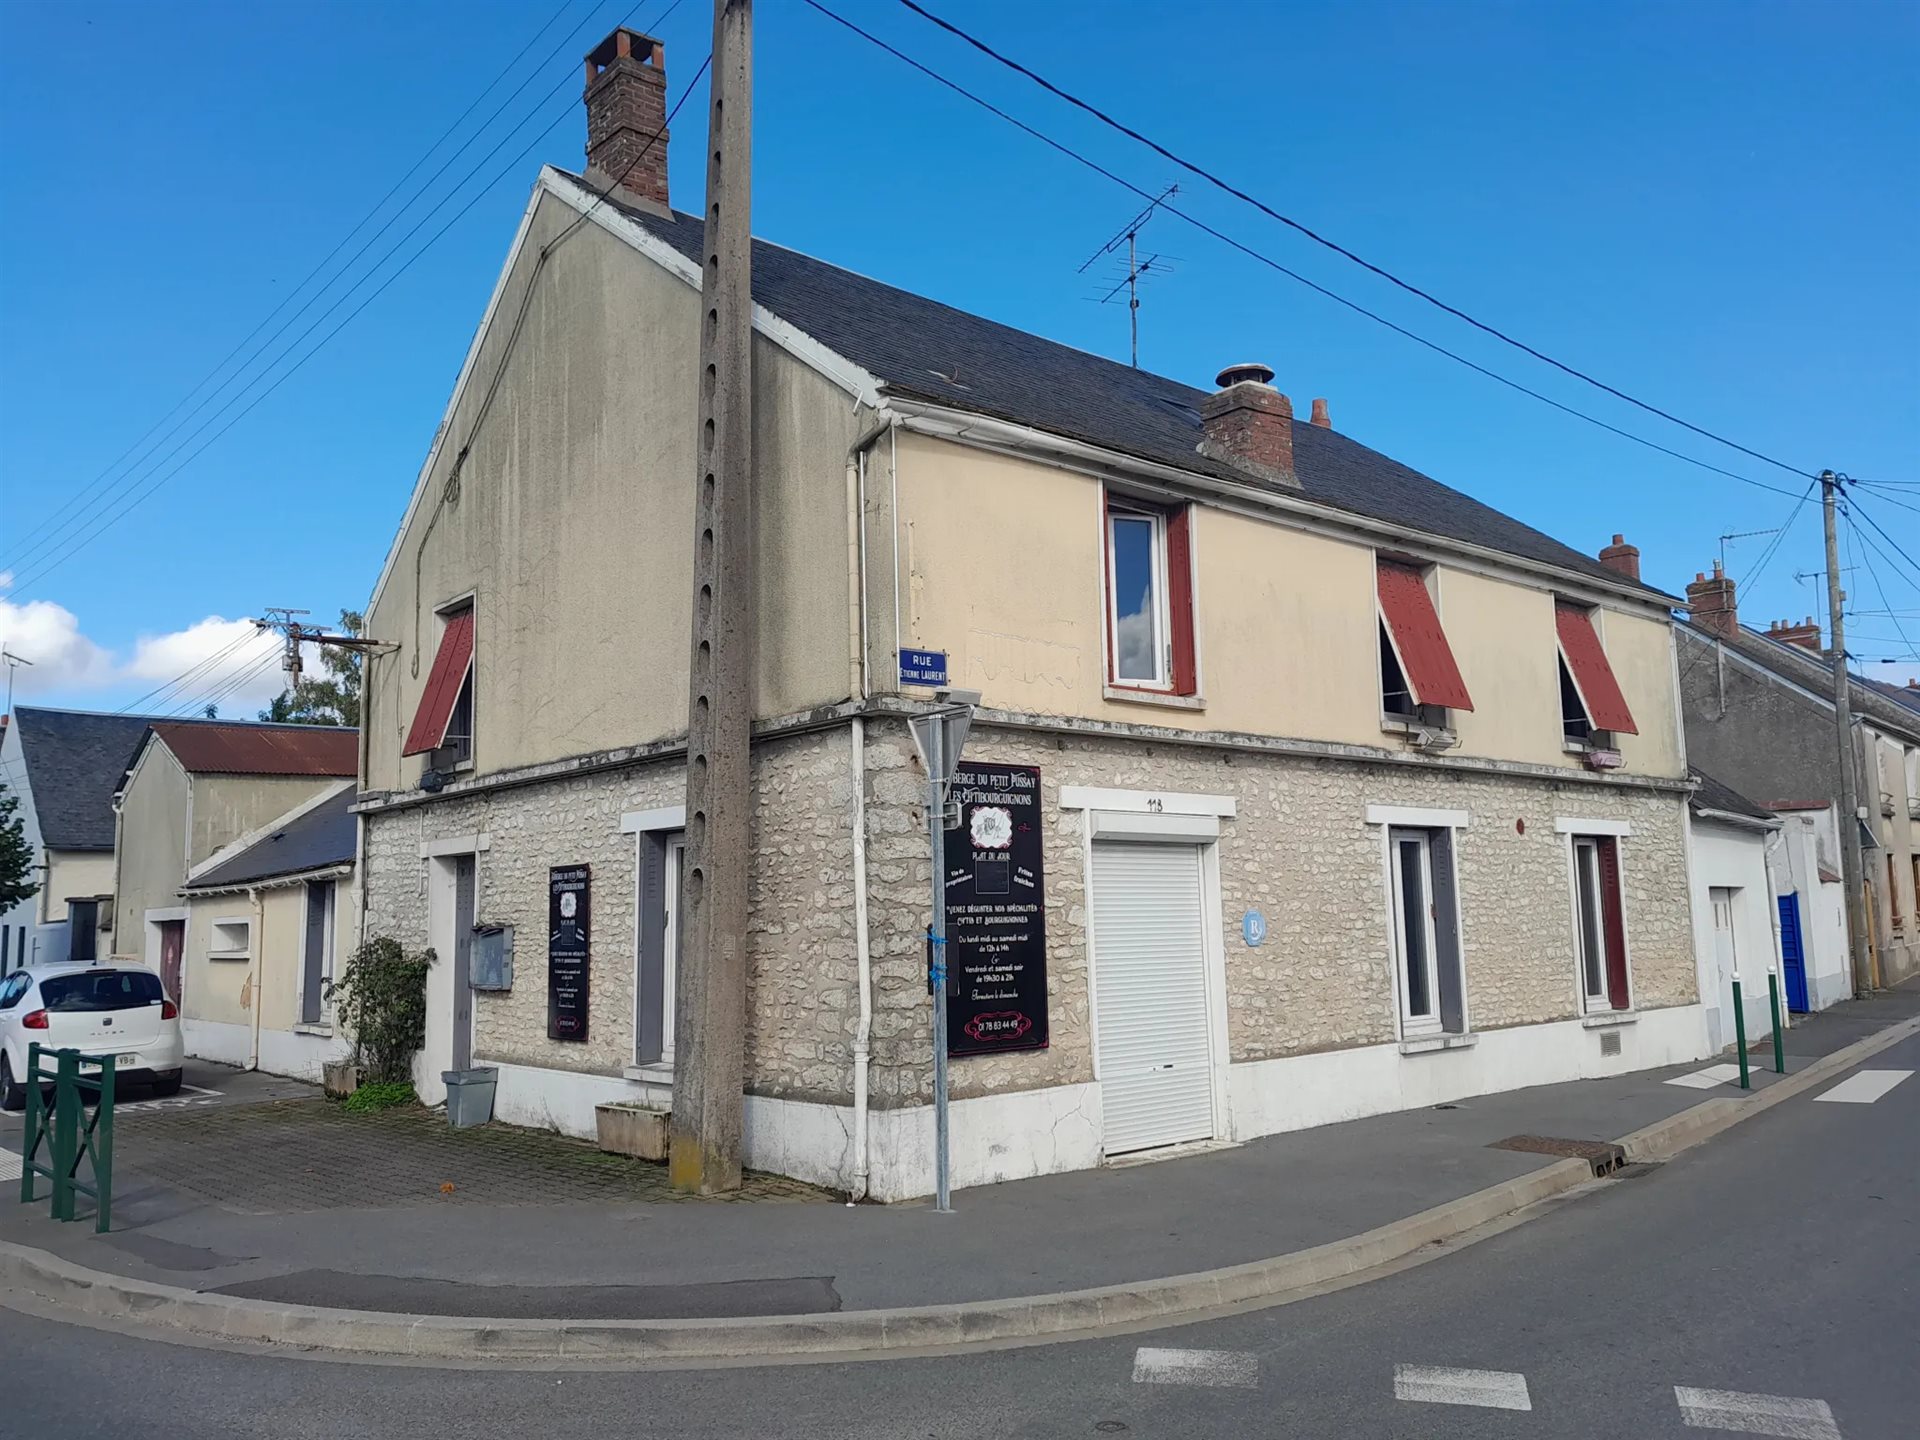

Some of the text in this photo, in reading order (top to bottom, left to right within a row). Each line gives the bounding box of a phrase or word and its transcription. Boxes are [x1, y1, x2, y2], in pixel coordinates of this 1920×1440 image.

[912, 654, 932, 667] RUE
[921, 670, 945, 681] LAURENT
[952, 772, 1036, 789] BERGE DU PETIT PUSSAY
[972, 851, 987, 861] PLAT
[975, 916, 983, 925] ET
[958, 935, 967, 944] Du
[967, 935, 980, 943] lundi
[980, 935, 991, 943] midi
[999, 934, 1017, 942] samedi
[1017, 934, 1028, 942] midi
[979, 945, 986, 953] de
[1000, 944, 1010, 952] 14h
[964, 965, 988, 973] Vendredi
[994, 964, 1013, 972] samedi
[983, 974, 1001, 983] 19h30
[1005, 973, 1015, 981] 21h
[985, 1021, 993, 1031] 78
[1002, 1020, 1010, 1029] 44
[1010, 1019, 1018, 1029] 49
